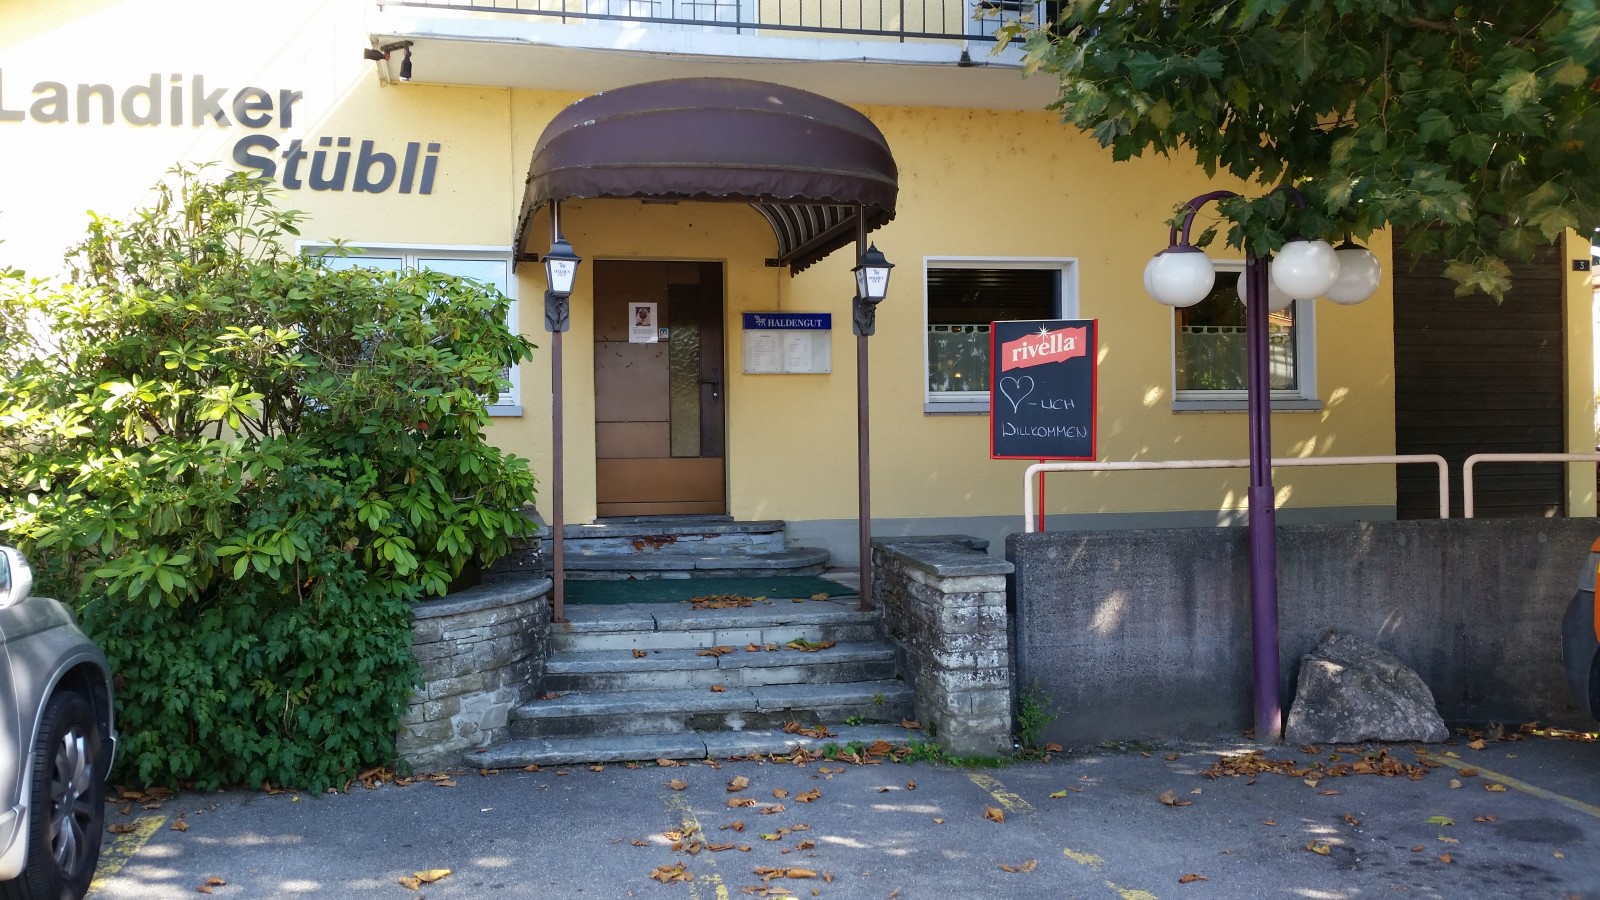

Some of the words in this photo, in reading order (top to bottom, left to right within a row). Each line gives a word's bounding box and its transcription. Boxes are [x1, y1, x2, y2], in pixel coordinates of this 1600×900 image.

[228, 134, 441, 195] Stübli
[1579, 261, 1585, 270] 3
[767, 318, 822, 328] HALDENGUT
[1012, 332, 1075, 362] rivella
